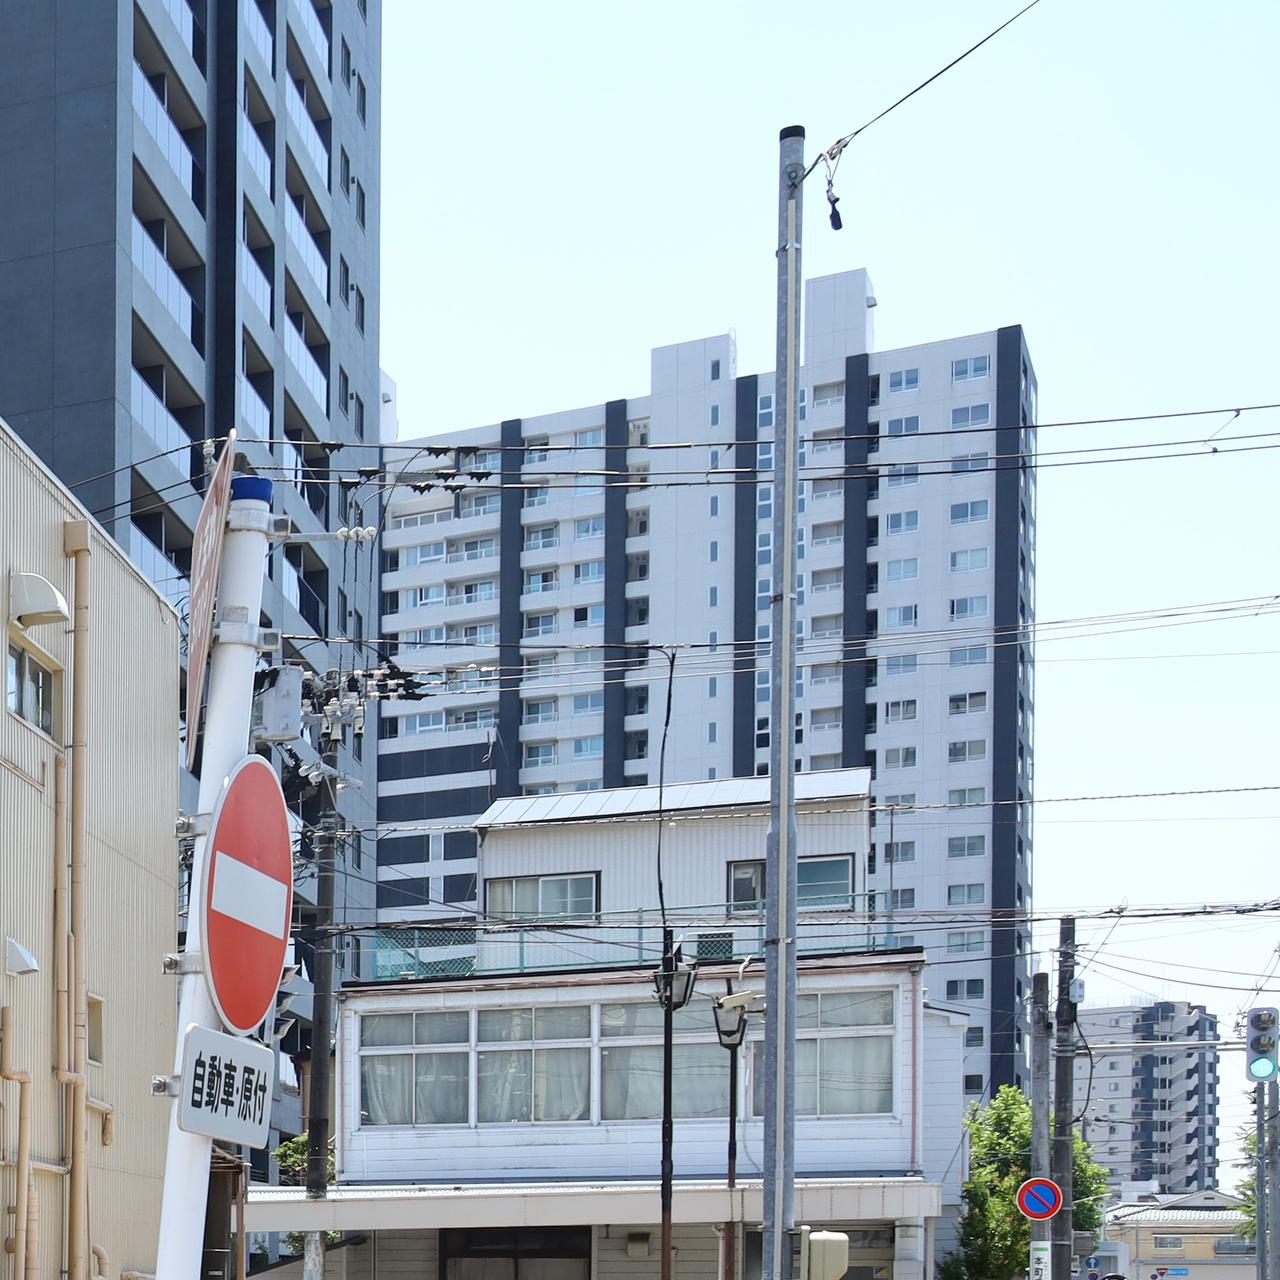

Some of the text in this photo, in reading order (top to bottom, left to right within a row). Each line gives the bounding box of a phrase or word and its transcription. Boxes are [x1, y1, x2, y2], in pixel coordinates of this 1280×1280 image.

[190, 1050, 268, 1126] 自動車・原付
